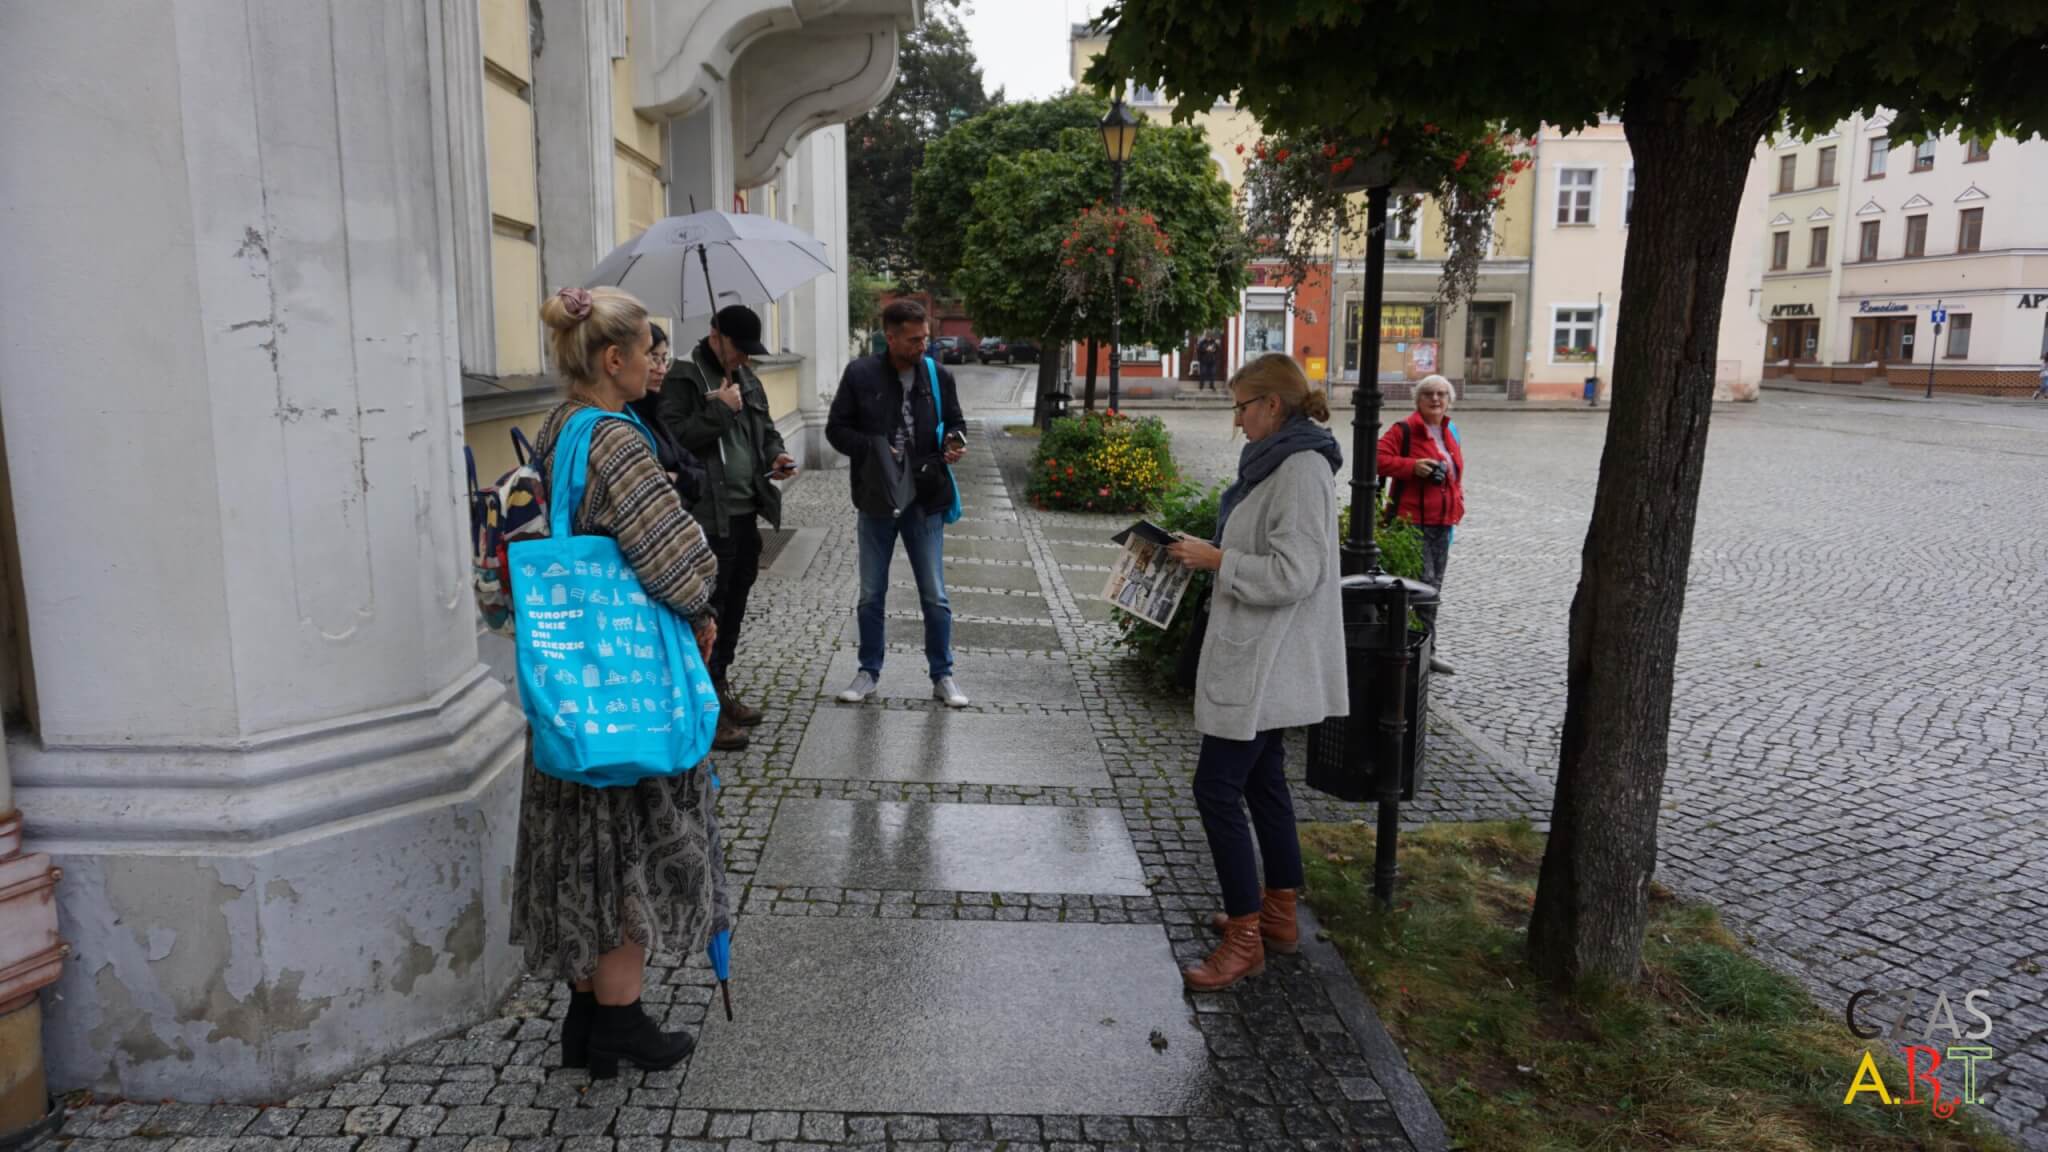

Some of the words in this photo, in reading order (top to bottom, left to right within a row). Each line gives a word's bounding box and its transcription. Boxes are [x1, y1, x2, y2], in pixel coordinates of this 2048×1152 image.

[2017, 294, 2048, 309] AP
[1771, 303, 1814, 316] APTEKA
[528, 610, 583, 619] EUROPEJ
[538, 621, 566, 630] SKIE
[531, 630, 551, 639] DNI
[532, 640, 585, 650] DZIEDZIC
[542, 650, 565, 660] TWA
